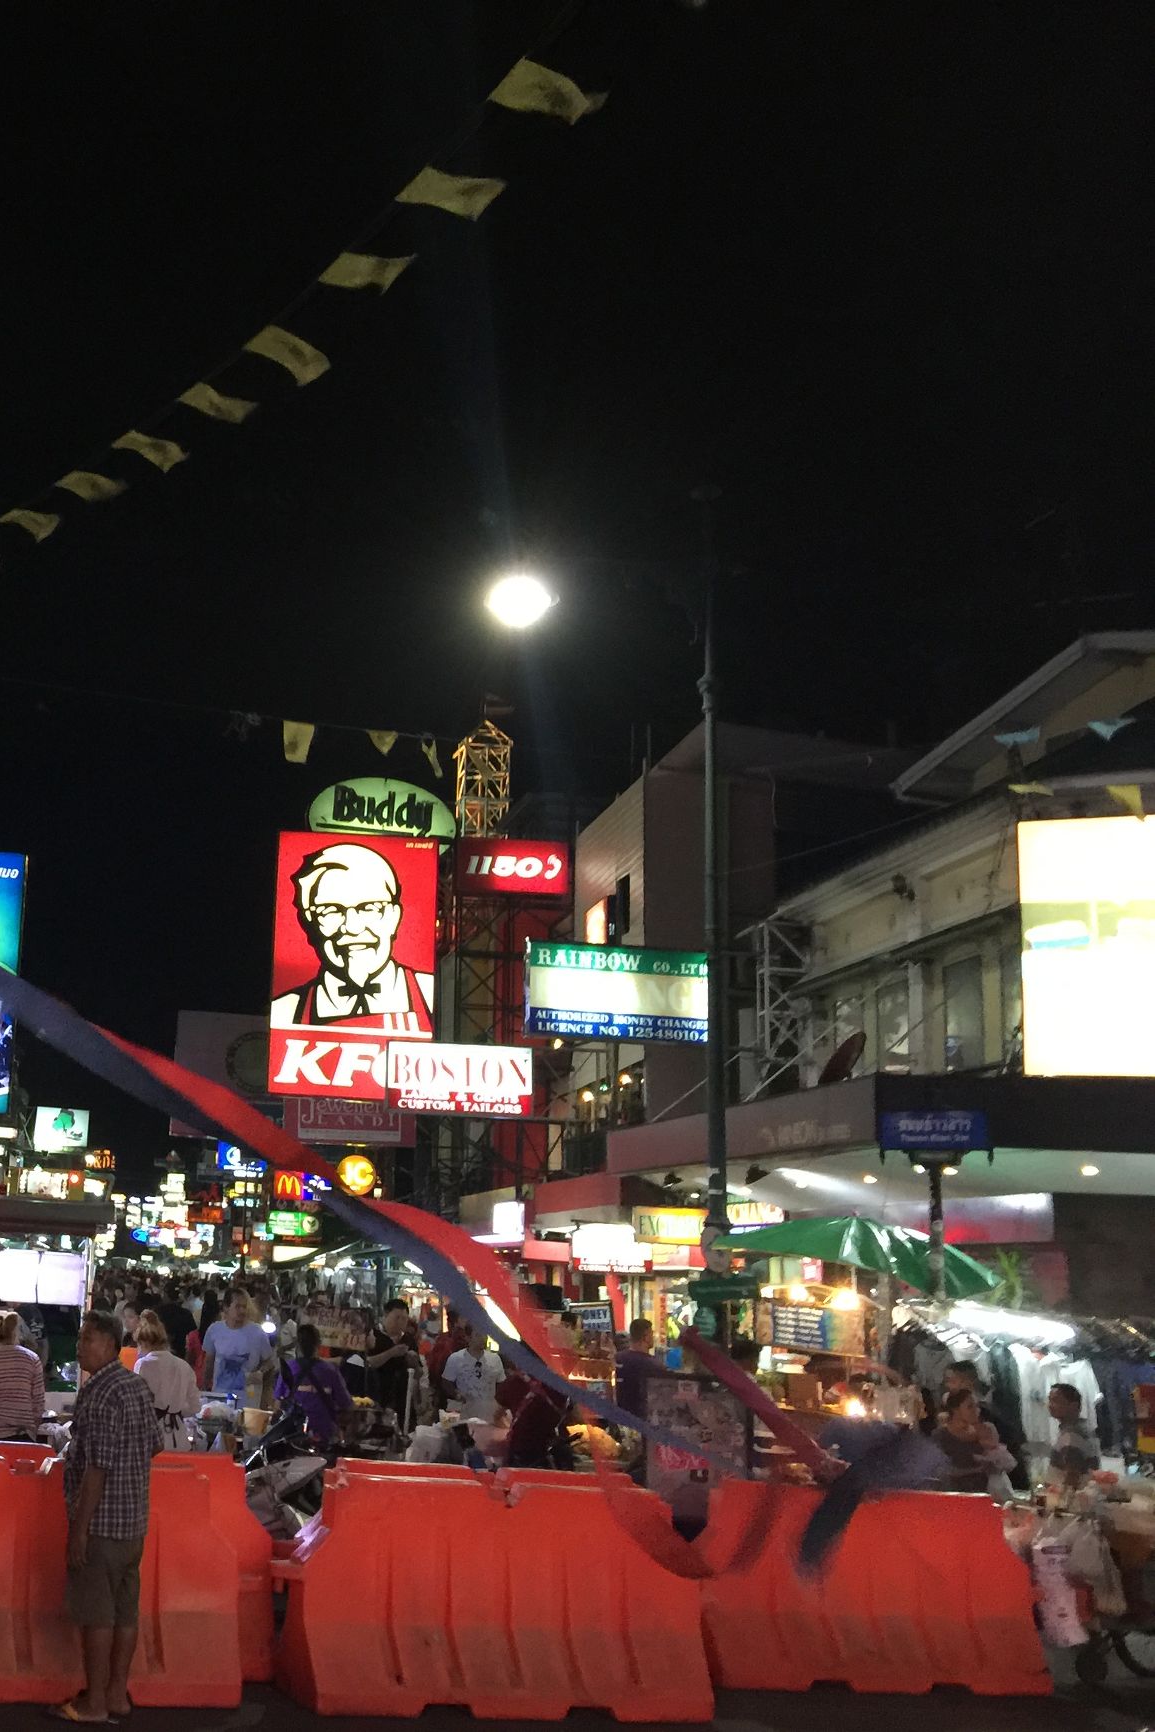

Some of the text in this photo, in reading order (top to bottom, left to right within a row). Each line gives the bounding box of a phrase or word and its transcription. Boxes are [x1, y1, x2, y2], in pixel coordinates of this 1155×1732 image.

[332, 784, 436, 837] Buddy
[466, 855, 543, 878] 1150
[537, 948, 642, 971] RAINBOW
[535, 1010, 609, 1024] AUTHORIZED
[613, 1014, 653, 1027] MONEY
[538, 1022, 593, 1035] LICENCE
[599, 1025, 621, 1037] NO.
[397, 1099, 523, 1115] CUSTOM TAILORS
